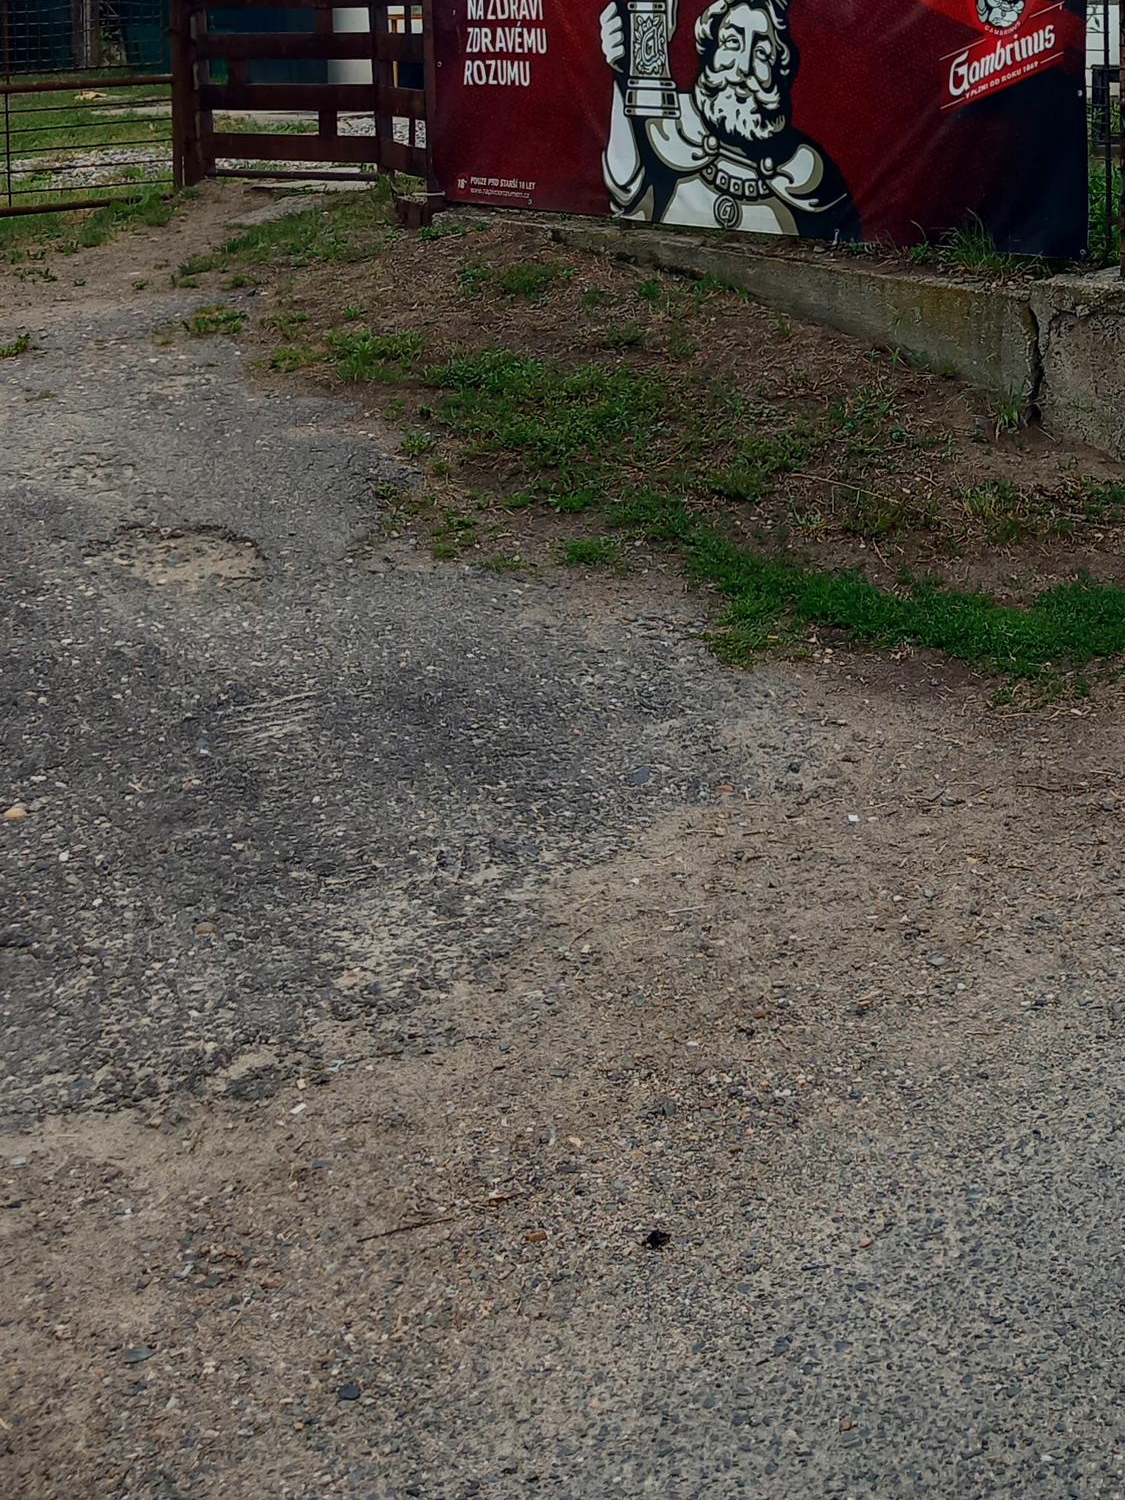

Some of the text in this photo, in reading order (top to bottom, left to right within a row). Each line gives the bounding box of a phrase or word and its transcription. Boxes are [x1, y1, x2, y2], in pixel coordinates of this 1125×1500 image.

[465, 21, 547, 54] ZDRAVÉMU
[463, 59, 531, 87] ROZUMU
[949, 24, 1056, 97] Gambrinus
[1001, 68, 1022, 83] ROKU
